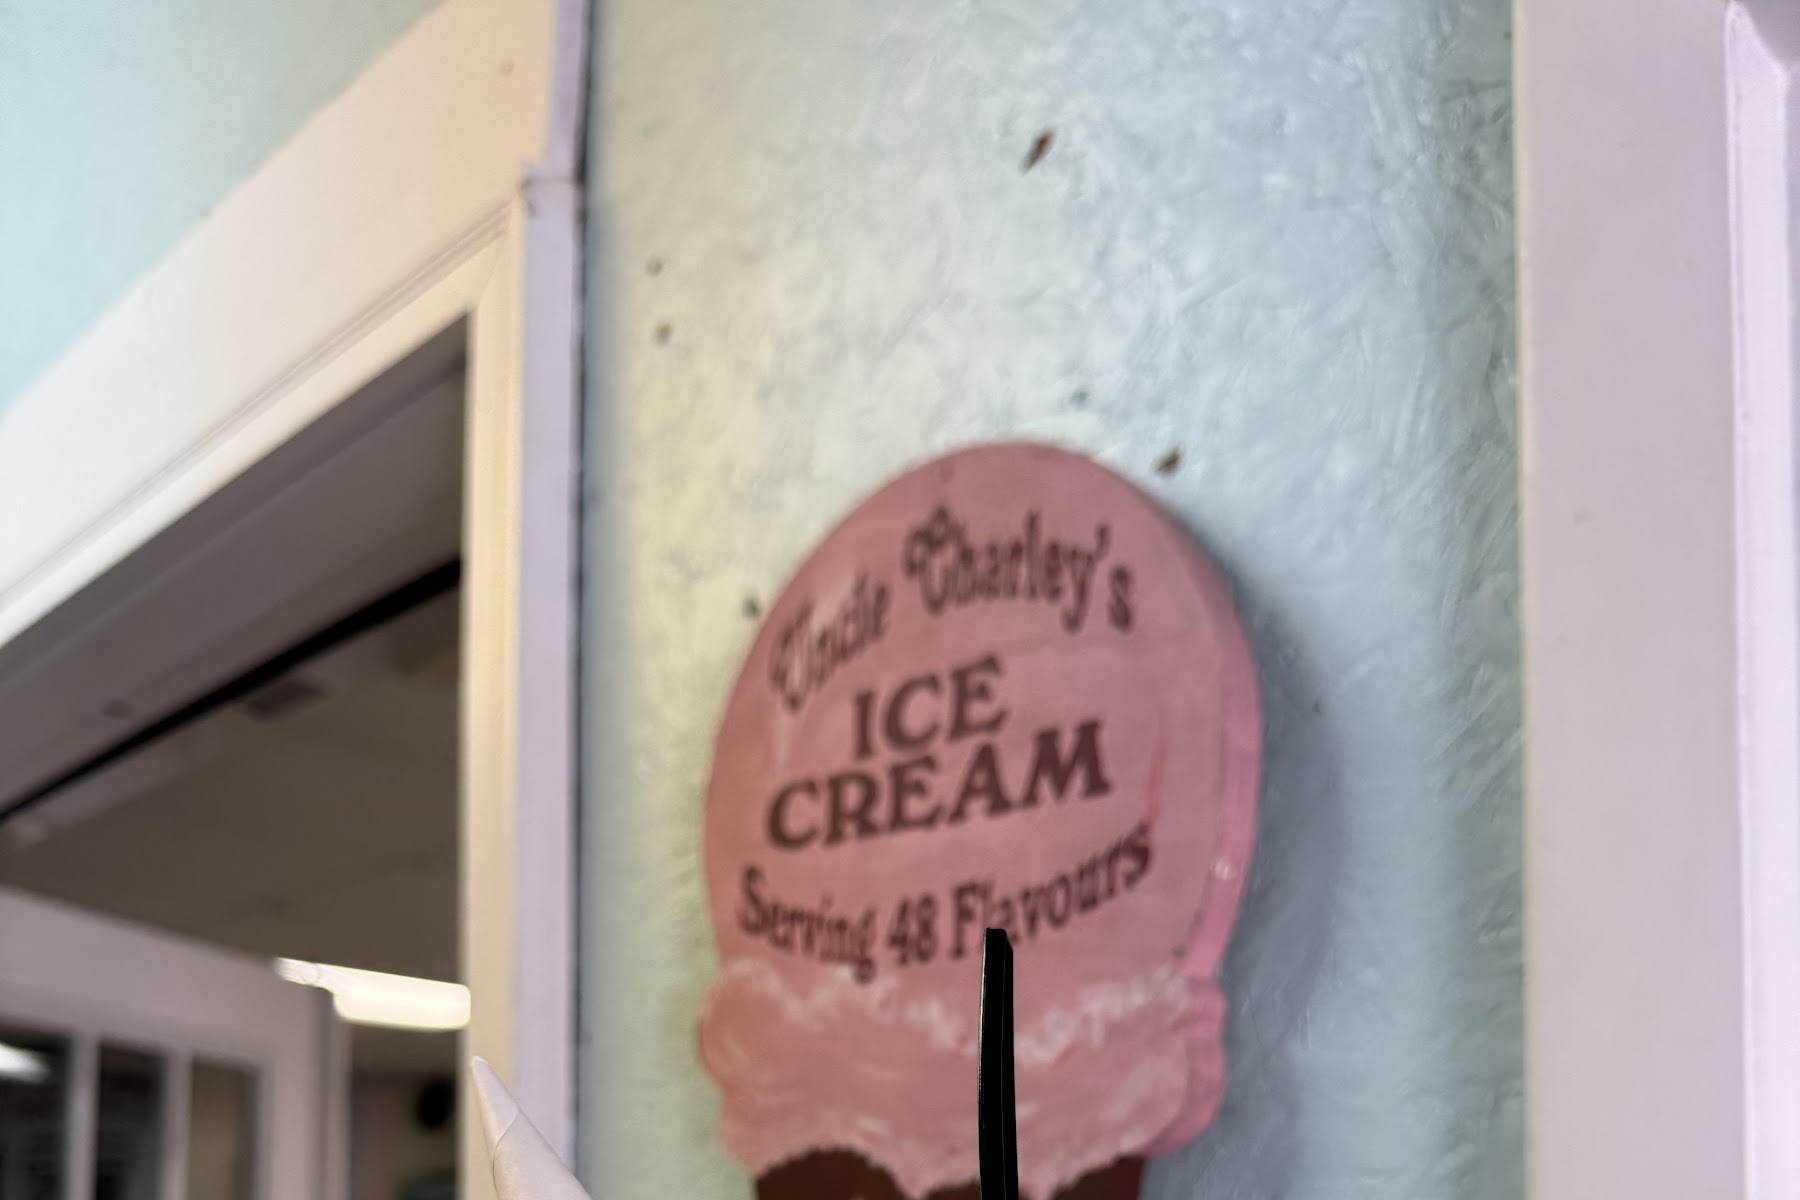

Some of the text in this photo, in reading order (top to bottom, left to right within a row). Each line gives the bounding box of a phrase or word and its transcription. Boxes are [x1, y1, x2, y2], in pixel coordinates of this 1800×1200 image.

[903, 503, 1136, 634] Charley's
[851, 655, 1008, 760] ICE
[767, 721, 1110, 850] CREAM
[737, 865, 877, 984] Serving
[886, 893, 940, 966] 48
